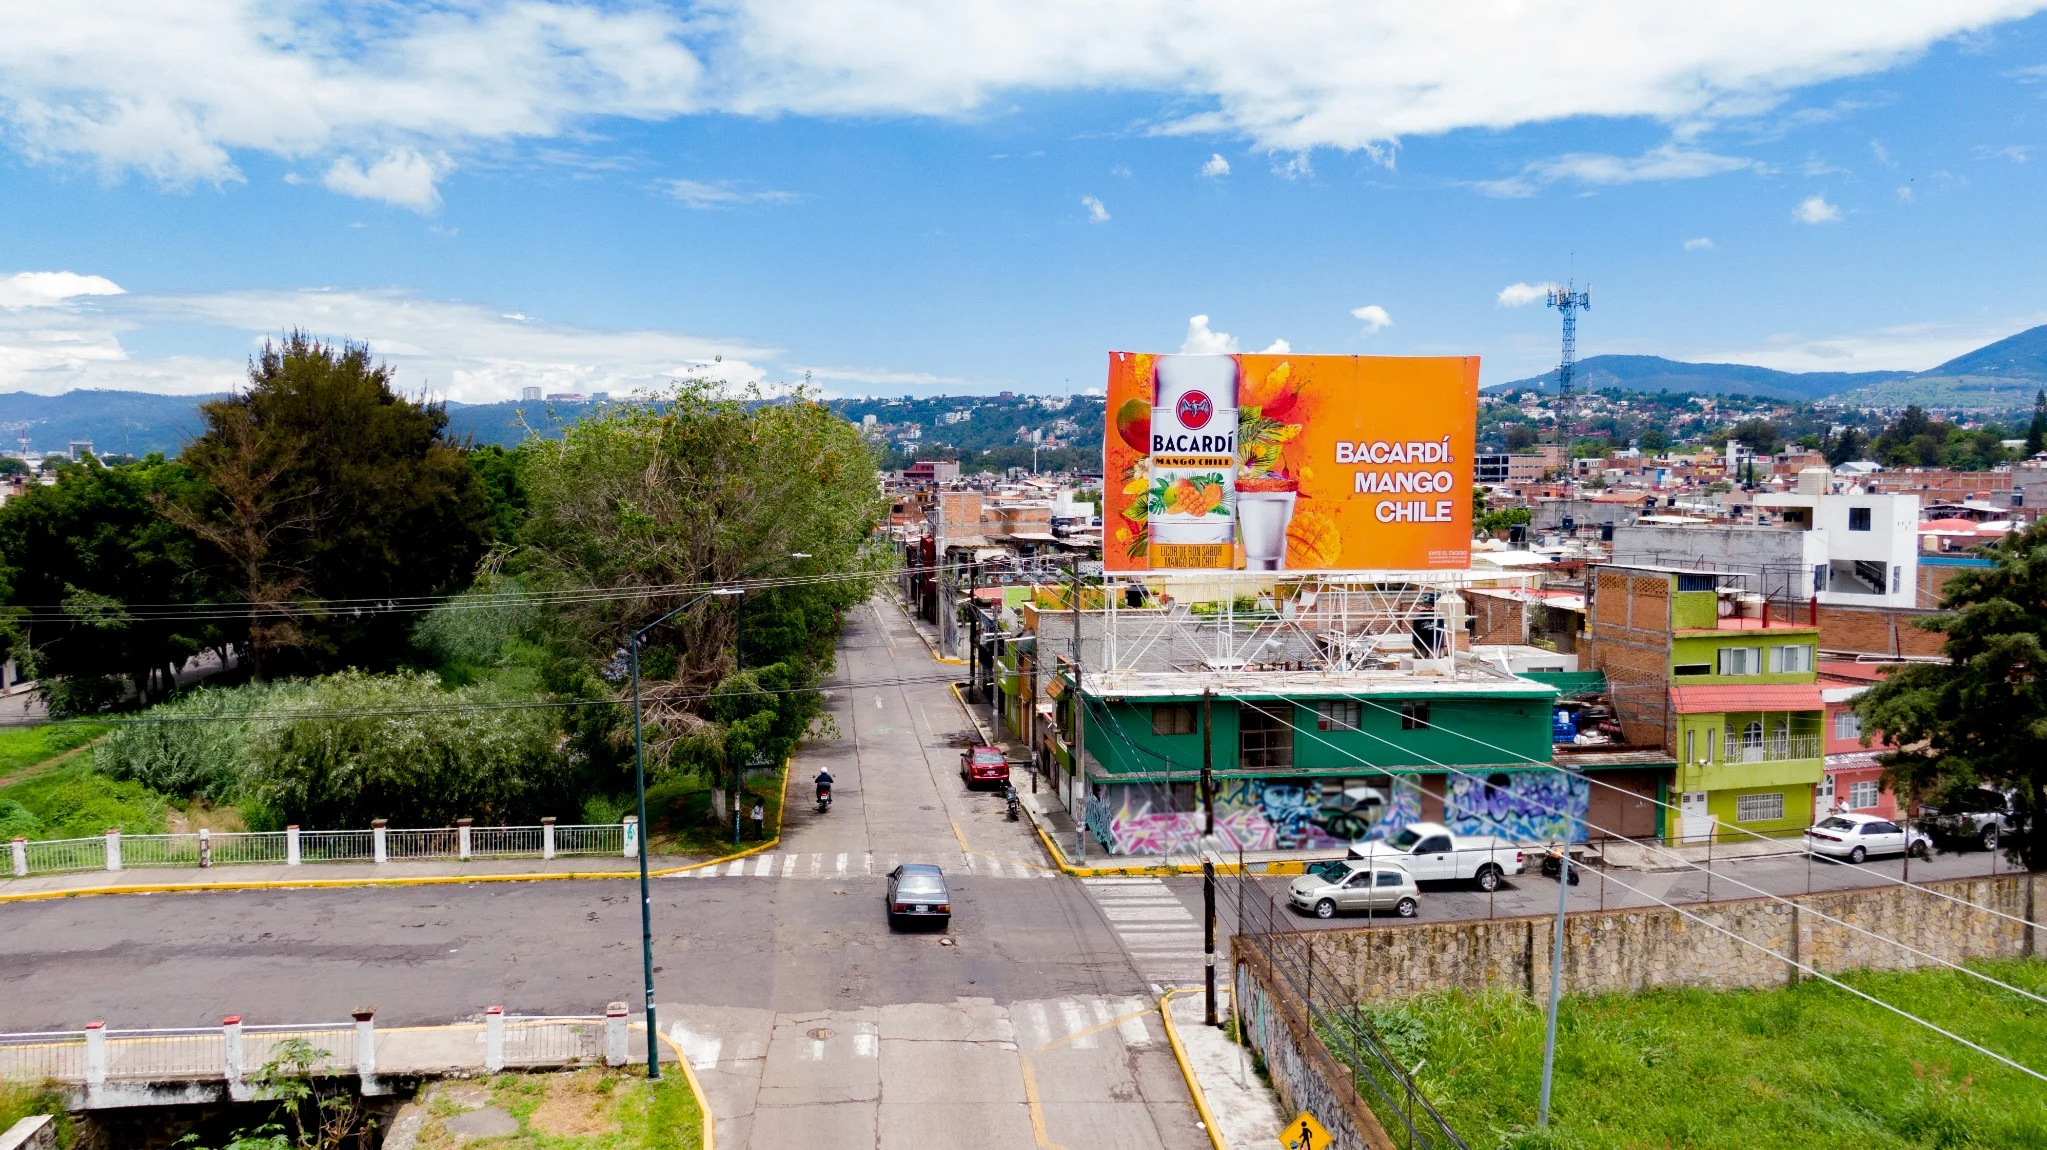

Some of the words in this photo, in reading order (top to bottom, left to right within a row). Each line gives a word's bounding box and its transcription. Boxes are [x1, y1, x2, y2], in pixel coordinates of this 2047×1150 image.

[1153, 431, 1233, 452] BACARDÍ
[1155, 458, 1195, 466] MANGO
[1355, 471, 1453, 493] MANGO
[1375, 501, 1453, 523] CHILE
[1160, 546, 1177, 556] LICOR
[1179, 546, 1186, 556] DE
[1189, 546, 1200, 556] RON
[1202, 546, 1223, 556] SABOR
[1164, 557, 1186, 567] MANGO
[1189, 557, 1200, 567] CON
[1202, 557, 1218, 567] CHILE
